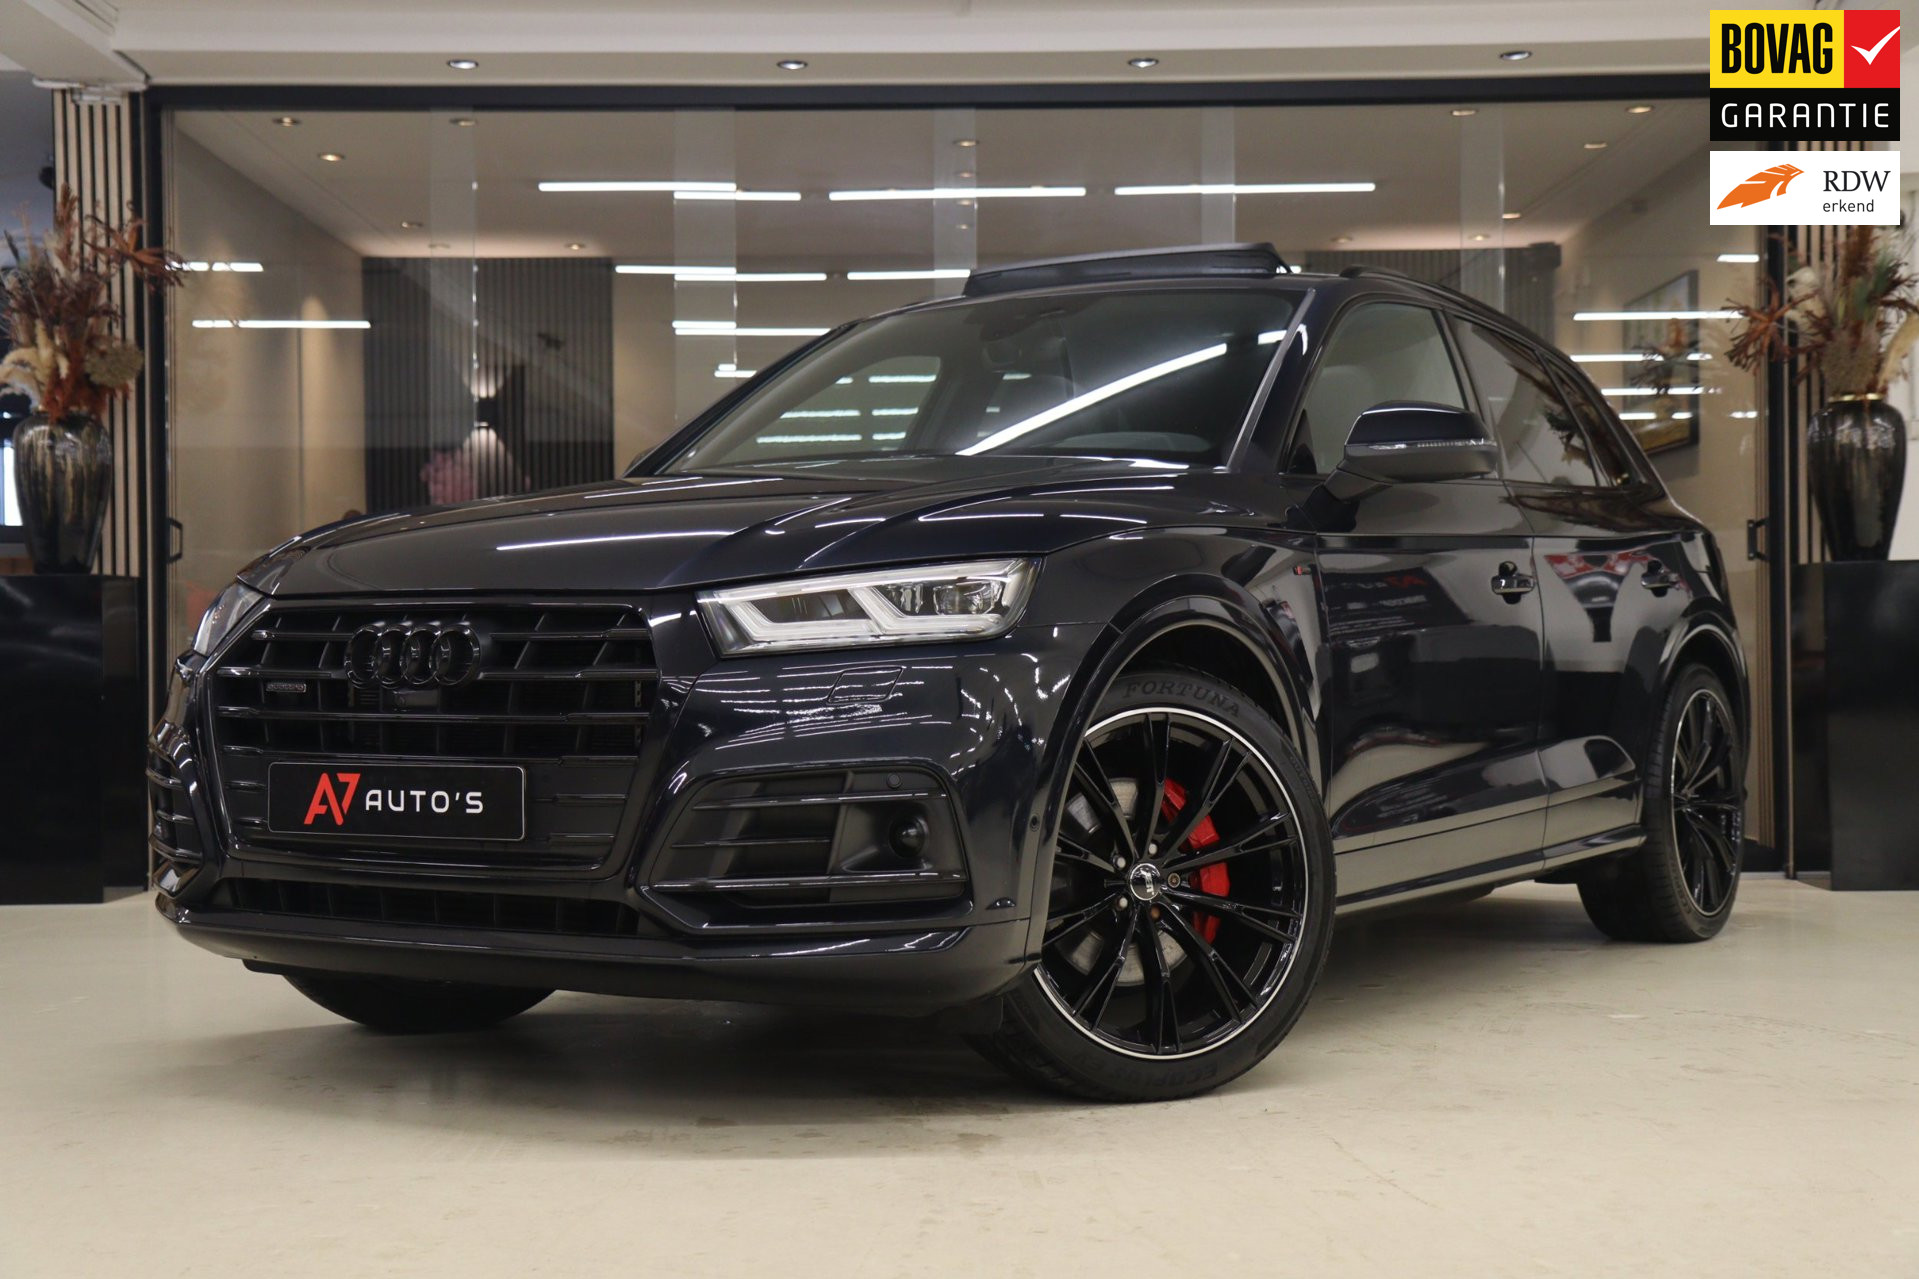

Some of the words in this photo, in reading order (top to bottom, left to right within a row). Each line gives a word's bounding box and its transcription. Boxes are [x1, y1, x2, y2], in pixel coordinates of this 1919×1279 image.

[1122, 680, 1240, 718] FORTUNA
[303, 772, 361, 826] A7
[365, 789, 484, 814] AUTO'S
